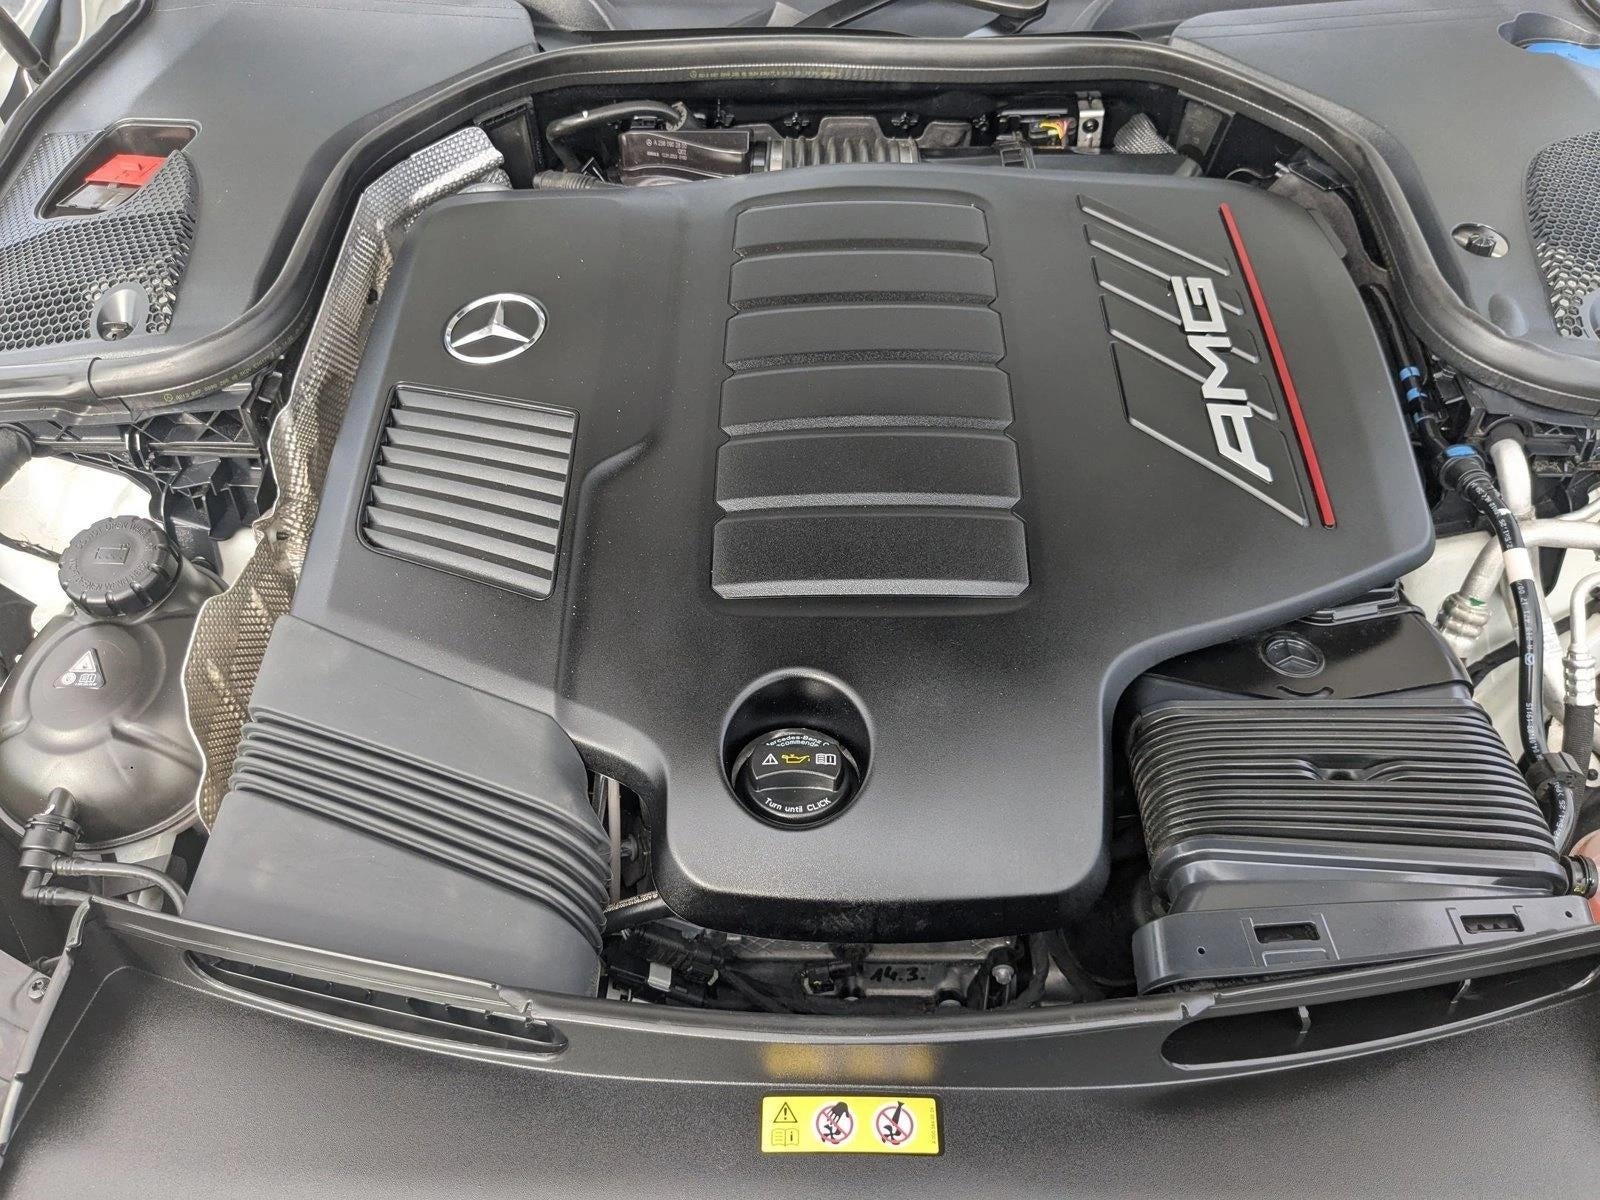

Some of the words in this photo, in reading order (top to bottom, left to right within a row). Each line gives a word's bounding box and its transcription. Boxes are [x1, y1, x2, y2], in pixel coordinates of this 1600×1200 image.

[1171, 276, 1273, 482] AMG
[765, 797, 782, 810] Turn
[784, 805, 803, 813] until
[806, 797, 832, 812] CLICK
[870, 966, 926, 983] 14.3.
